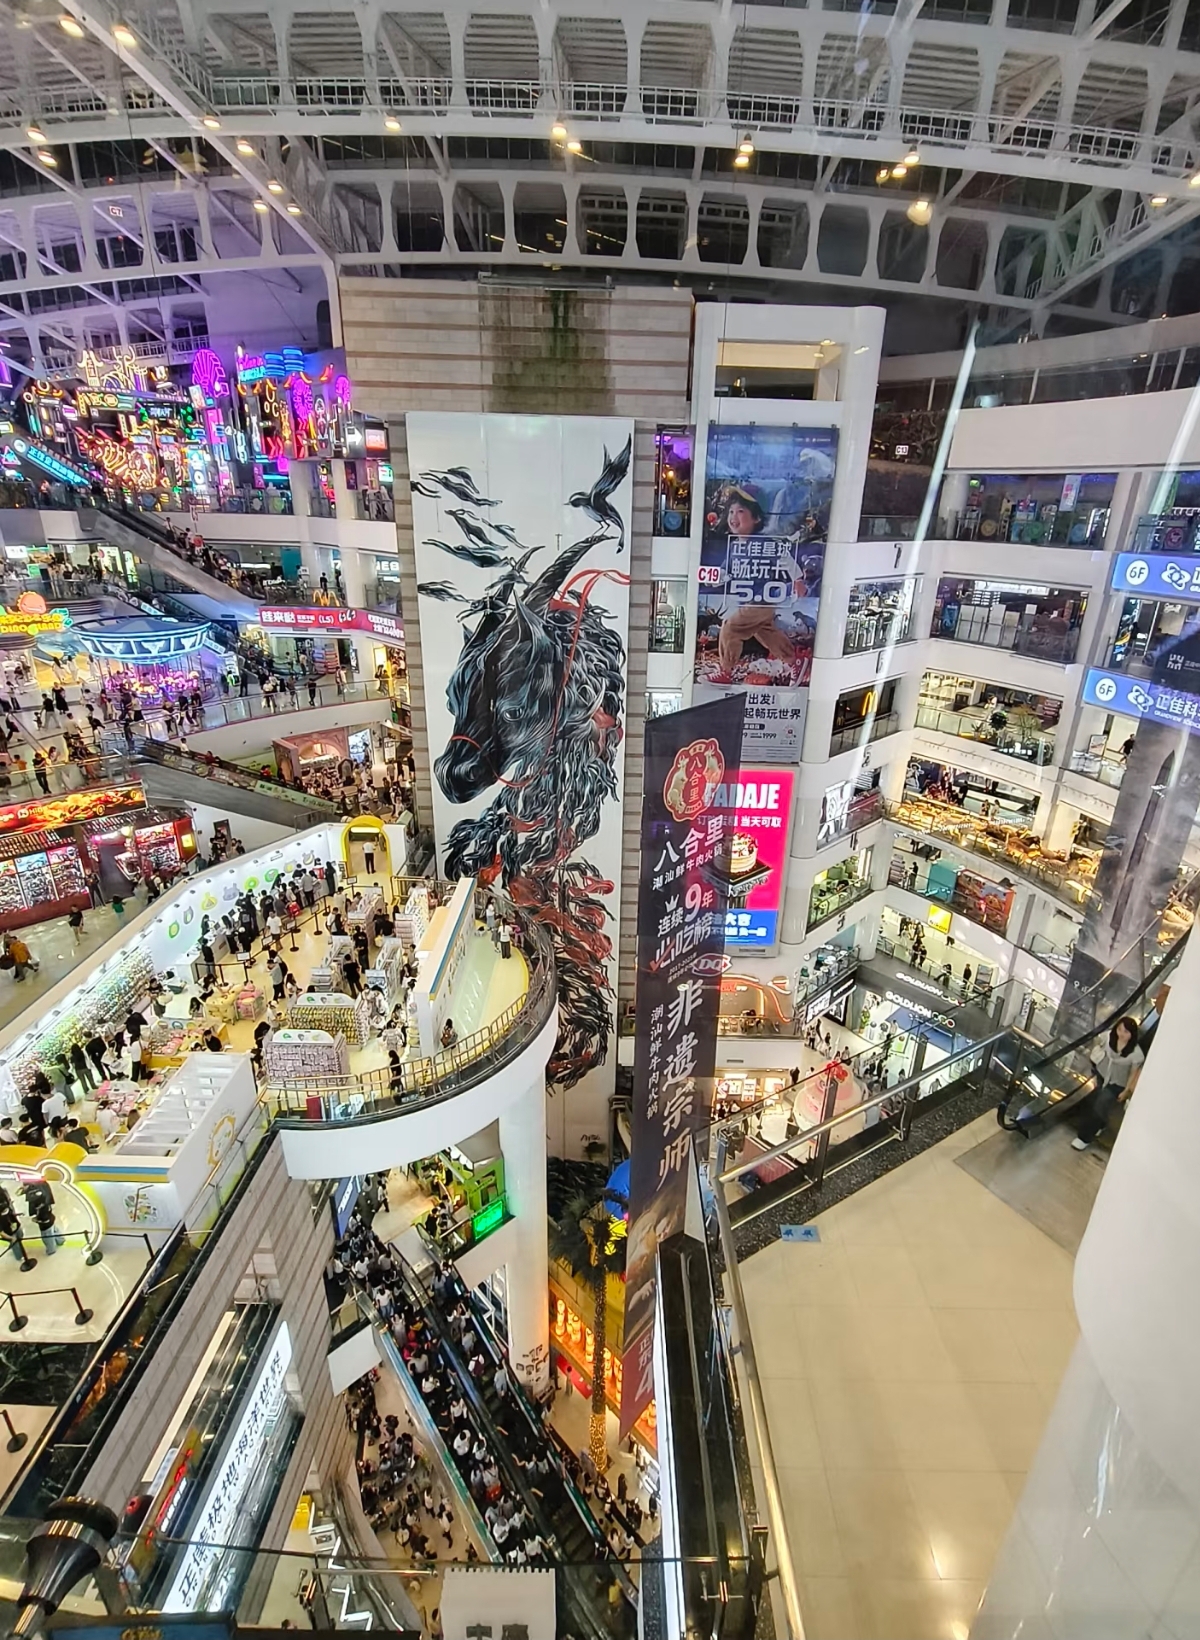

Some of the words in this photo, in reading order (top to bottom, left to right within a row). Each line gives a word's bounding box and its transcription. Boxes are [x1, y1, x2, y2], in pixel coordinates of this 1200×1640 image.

[732, 541, 792, 557] 正佳星球
[698, 567, 720, 582] C19
[732, 559, 787, 580] 畅玩卡
[1129, 566, 1146, 579] 6F
[729, 581, 787, 602] 5.0
[1098, 683, 1114, 696] 6F
[689, 756, 703, 804] 八合里
[740, 815, 782, 828] 当天可取
[653, 814, 724, 872] 八合里
[652, 843, 722, 891] 潮汕鲜牛肉火锅
[896, 972, 943, 998] GOLDLION
[885, 990, 932, 1019] GOLDLION
[656, 977, 703, 1191] 非遗宗师
[178, 1350, 281, 1605] 正佳极地海洋世界
